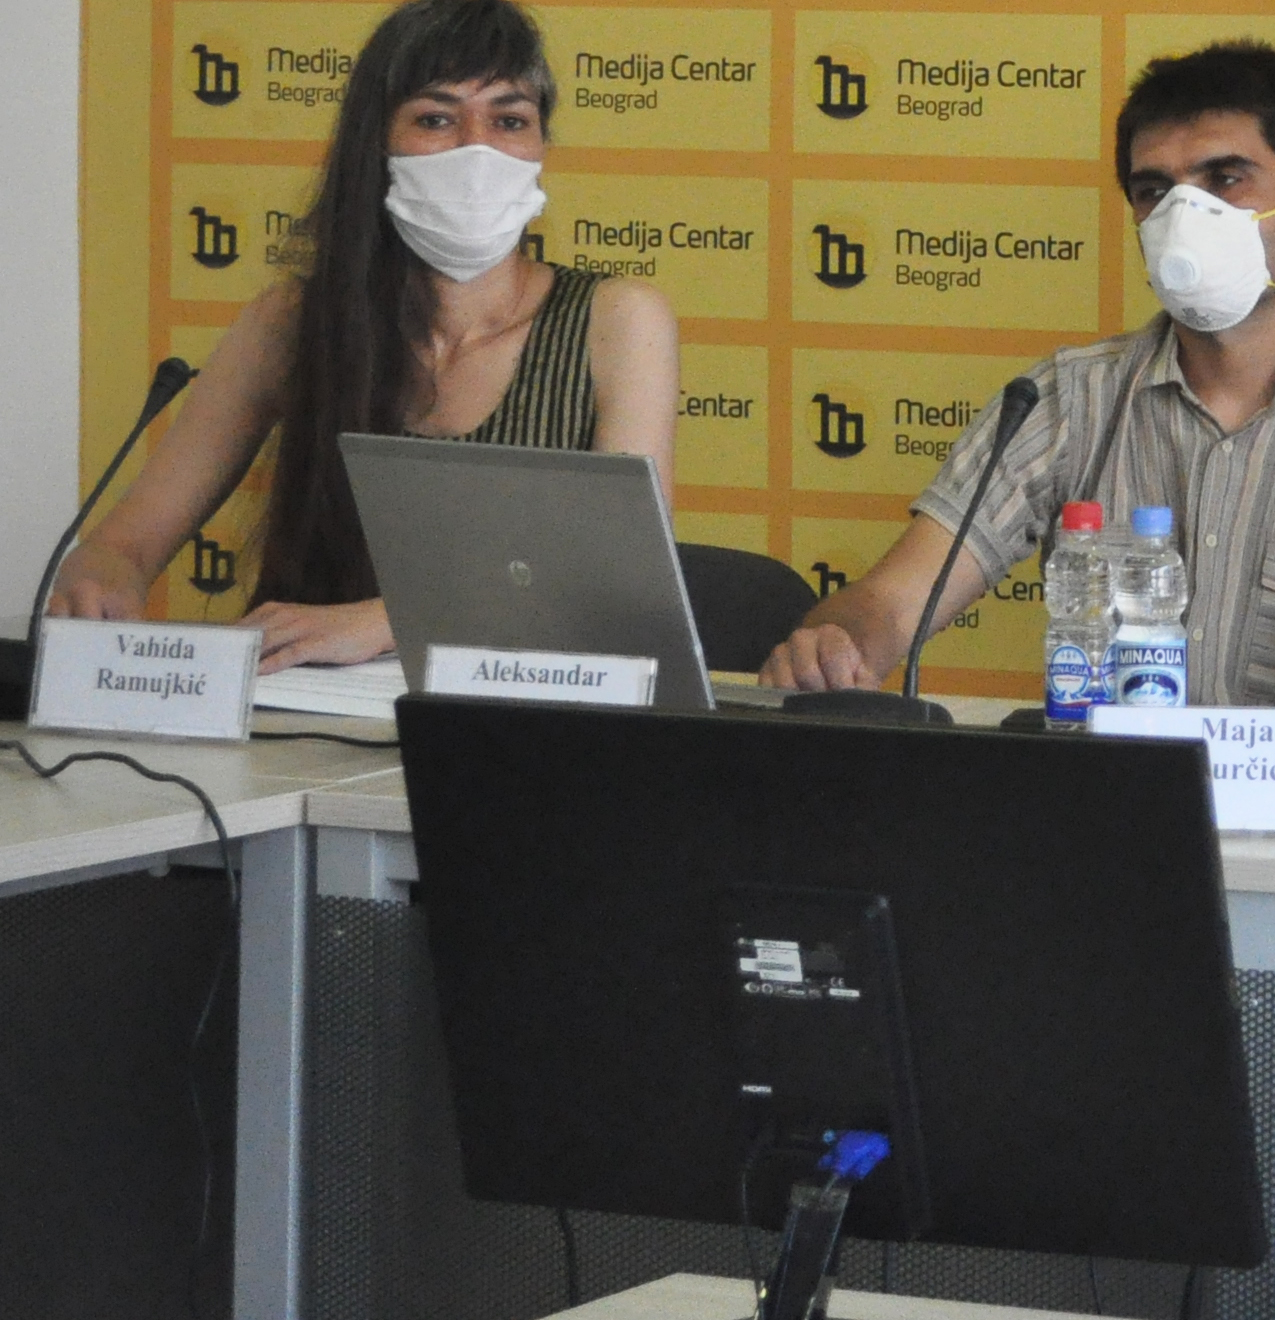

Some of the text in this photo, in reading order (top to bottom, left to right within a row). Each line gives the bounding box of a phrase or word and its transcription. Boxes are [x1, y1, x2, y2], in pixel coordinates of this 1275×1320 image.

[576, 52, 757, 87] Medija Centar
[576, 88, 658, 114] Beograd
[574, 219, 754, 257] Medija Centar
[895, 228, 1084, 267] Medija Centar
[895, 264, 981, 292] Beograd
[117, 633, 195, 660] Vahida
[1118, 648, 1183, 665] MINAQUA
[97, 667, 207, 699] Ramujkić
[471, 658, 608, 687] Aleksandar
[1202, 717, 1274, 749] Maja
